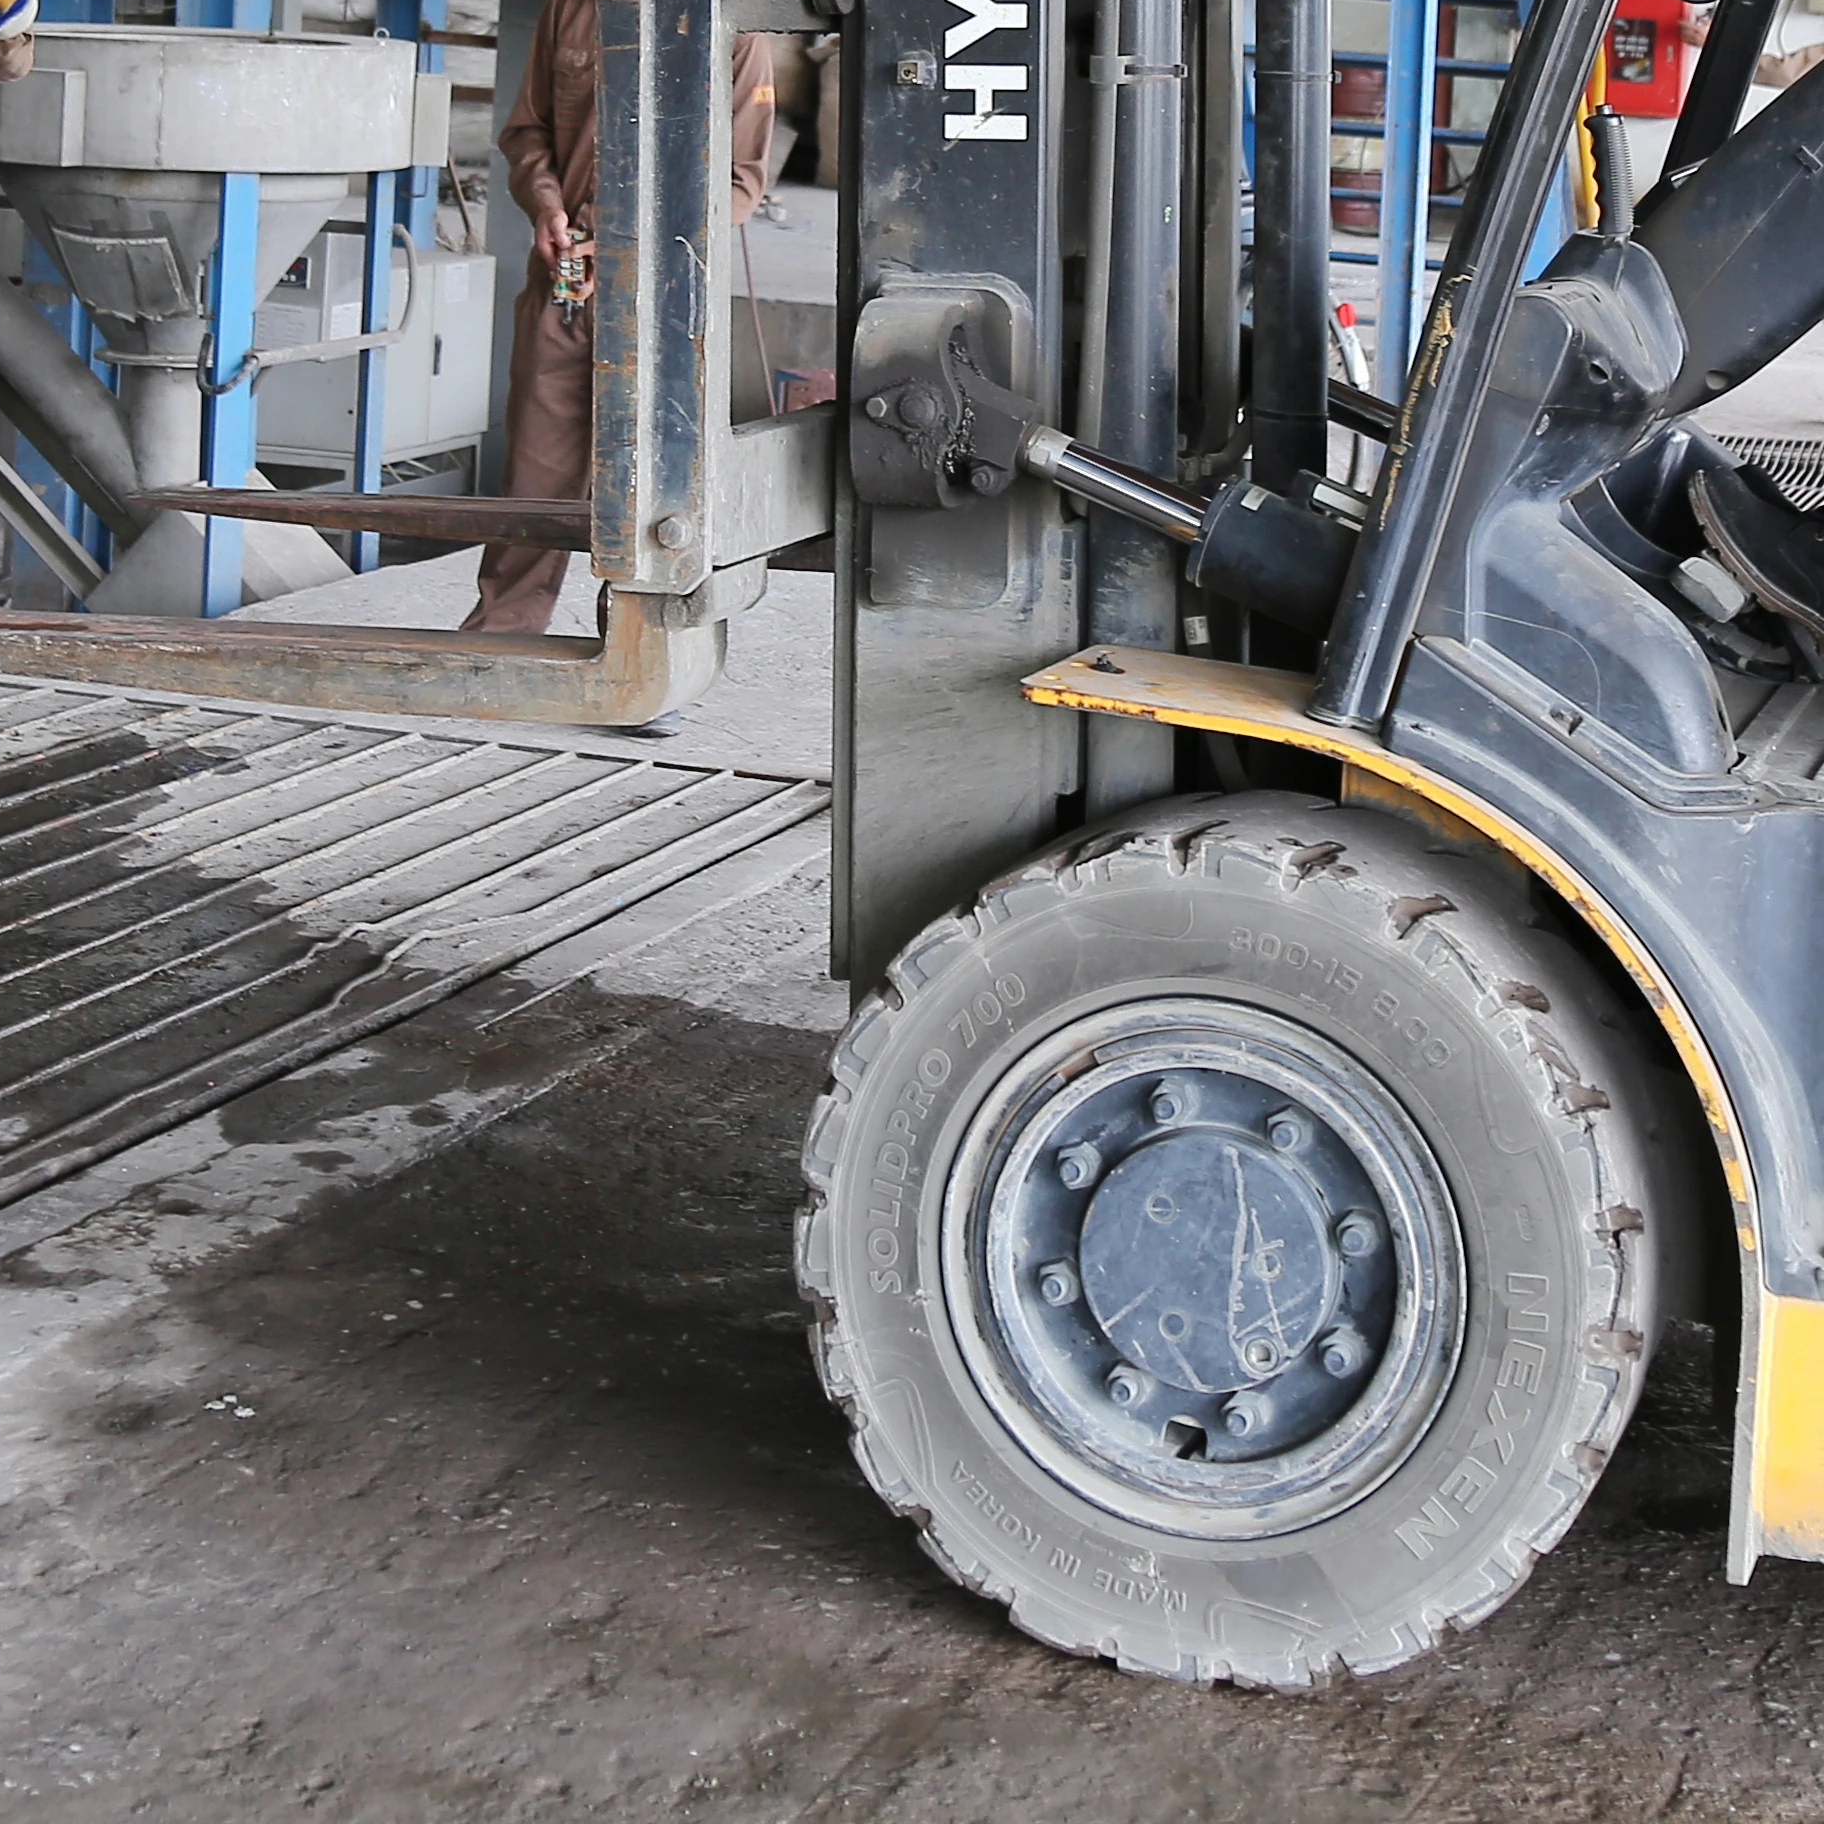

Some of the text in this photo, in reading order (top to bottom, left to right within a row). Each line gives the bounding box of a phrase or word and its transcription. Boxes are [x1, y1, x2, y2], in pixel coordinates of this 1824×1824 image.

[1228, 926, 1453, 1069] 300-15 8.00
[867, 972, 1026, 1295] SOLIDPRO 700
[1393, 1271, 1550, 1560] NEXEN
[950, 1459, 1188, 1612] MADE IN KOREA
